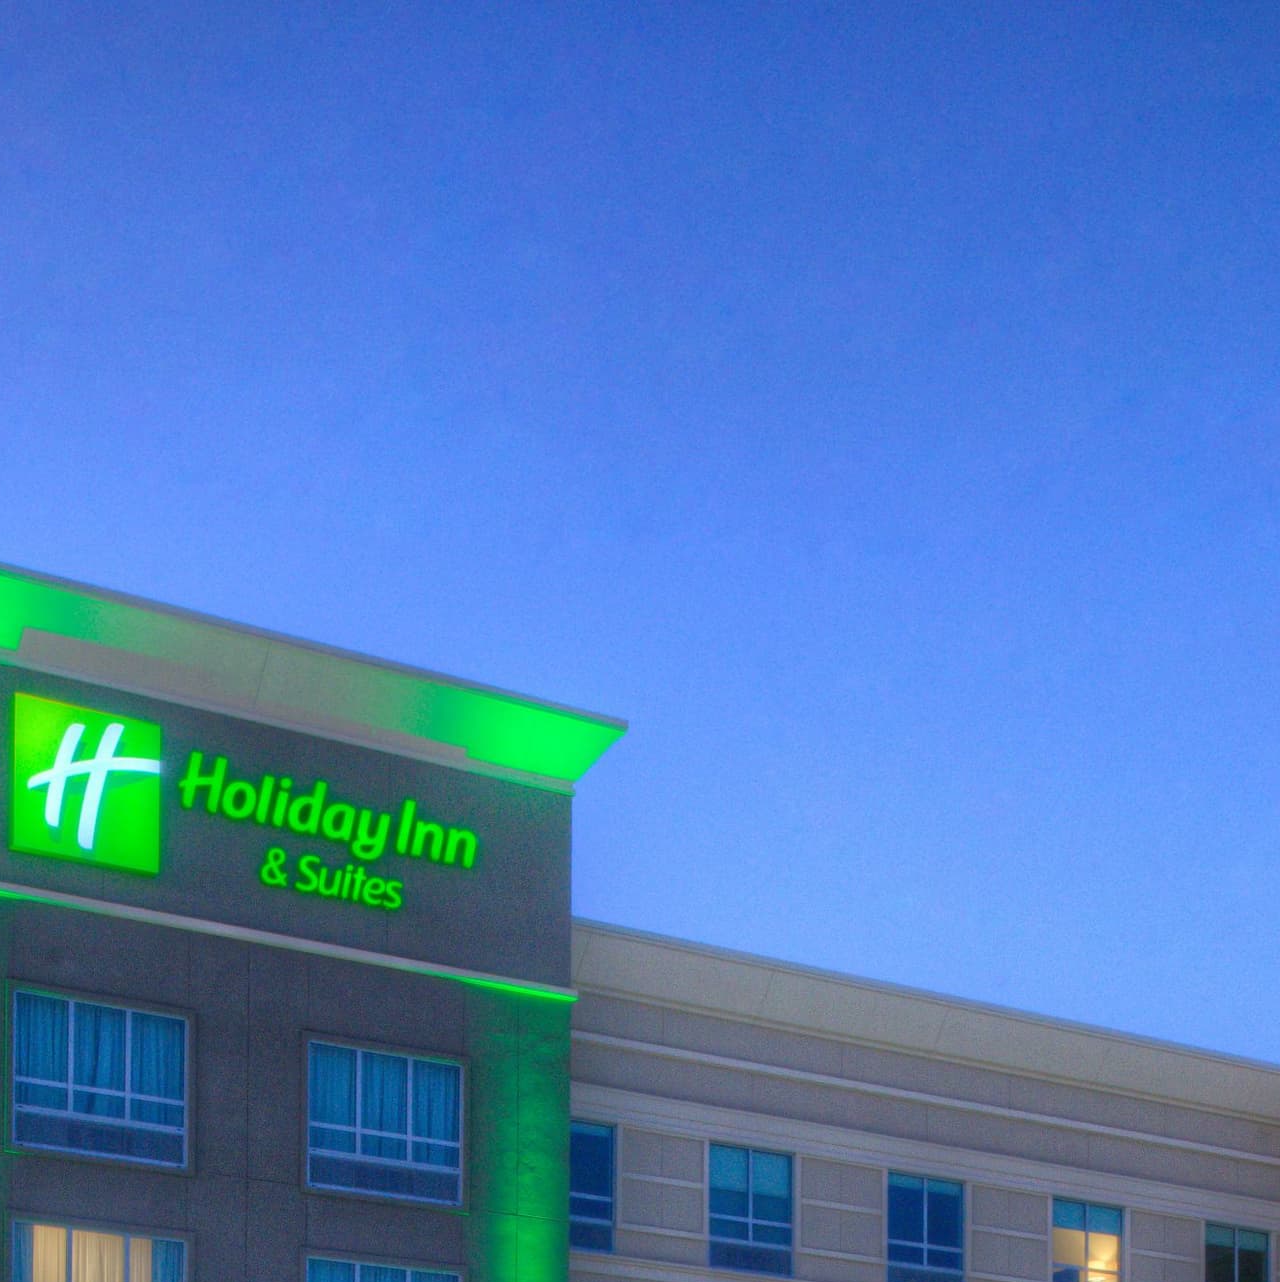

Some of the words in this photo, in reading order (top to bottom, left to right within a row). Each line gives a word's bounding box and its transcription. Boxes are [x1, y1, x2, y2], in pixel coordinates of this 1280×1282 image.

[178, 751, 391, 860] Holiday
[396, 800, 477, 868] Inn
[261, 847, 287, 887] &
[295, 855, 403, 909] Suites
